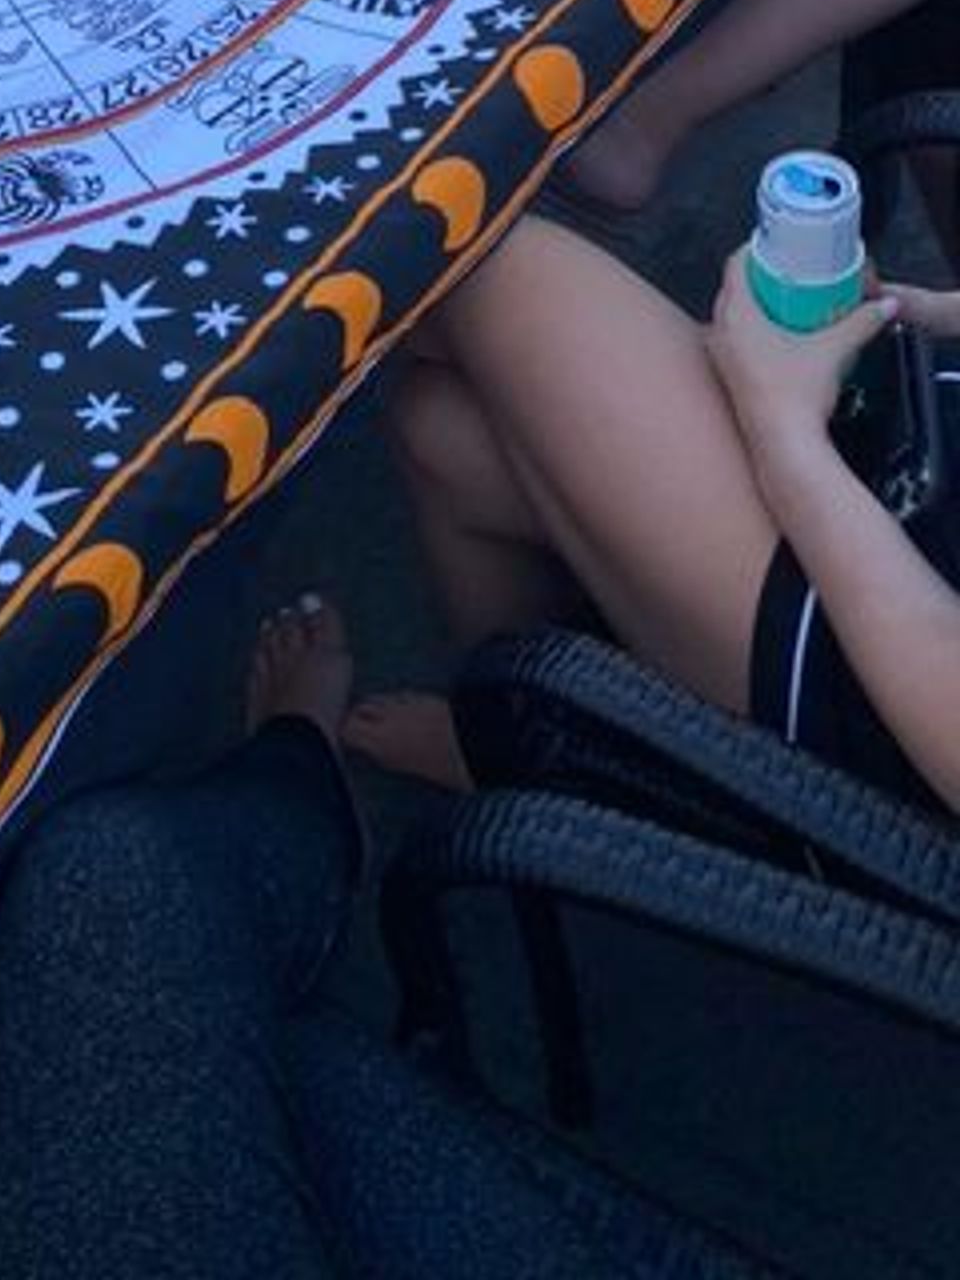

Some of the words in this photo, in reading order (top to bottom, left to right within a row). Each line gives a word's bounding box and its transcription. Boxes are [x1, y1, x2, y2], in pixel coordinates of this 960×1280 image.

[203, 3, 259, 38] 25
[153, 38, 209, 77] 26
[102, 71, 147, 110] 27
[26, 97, 82, 129] 28
